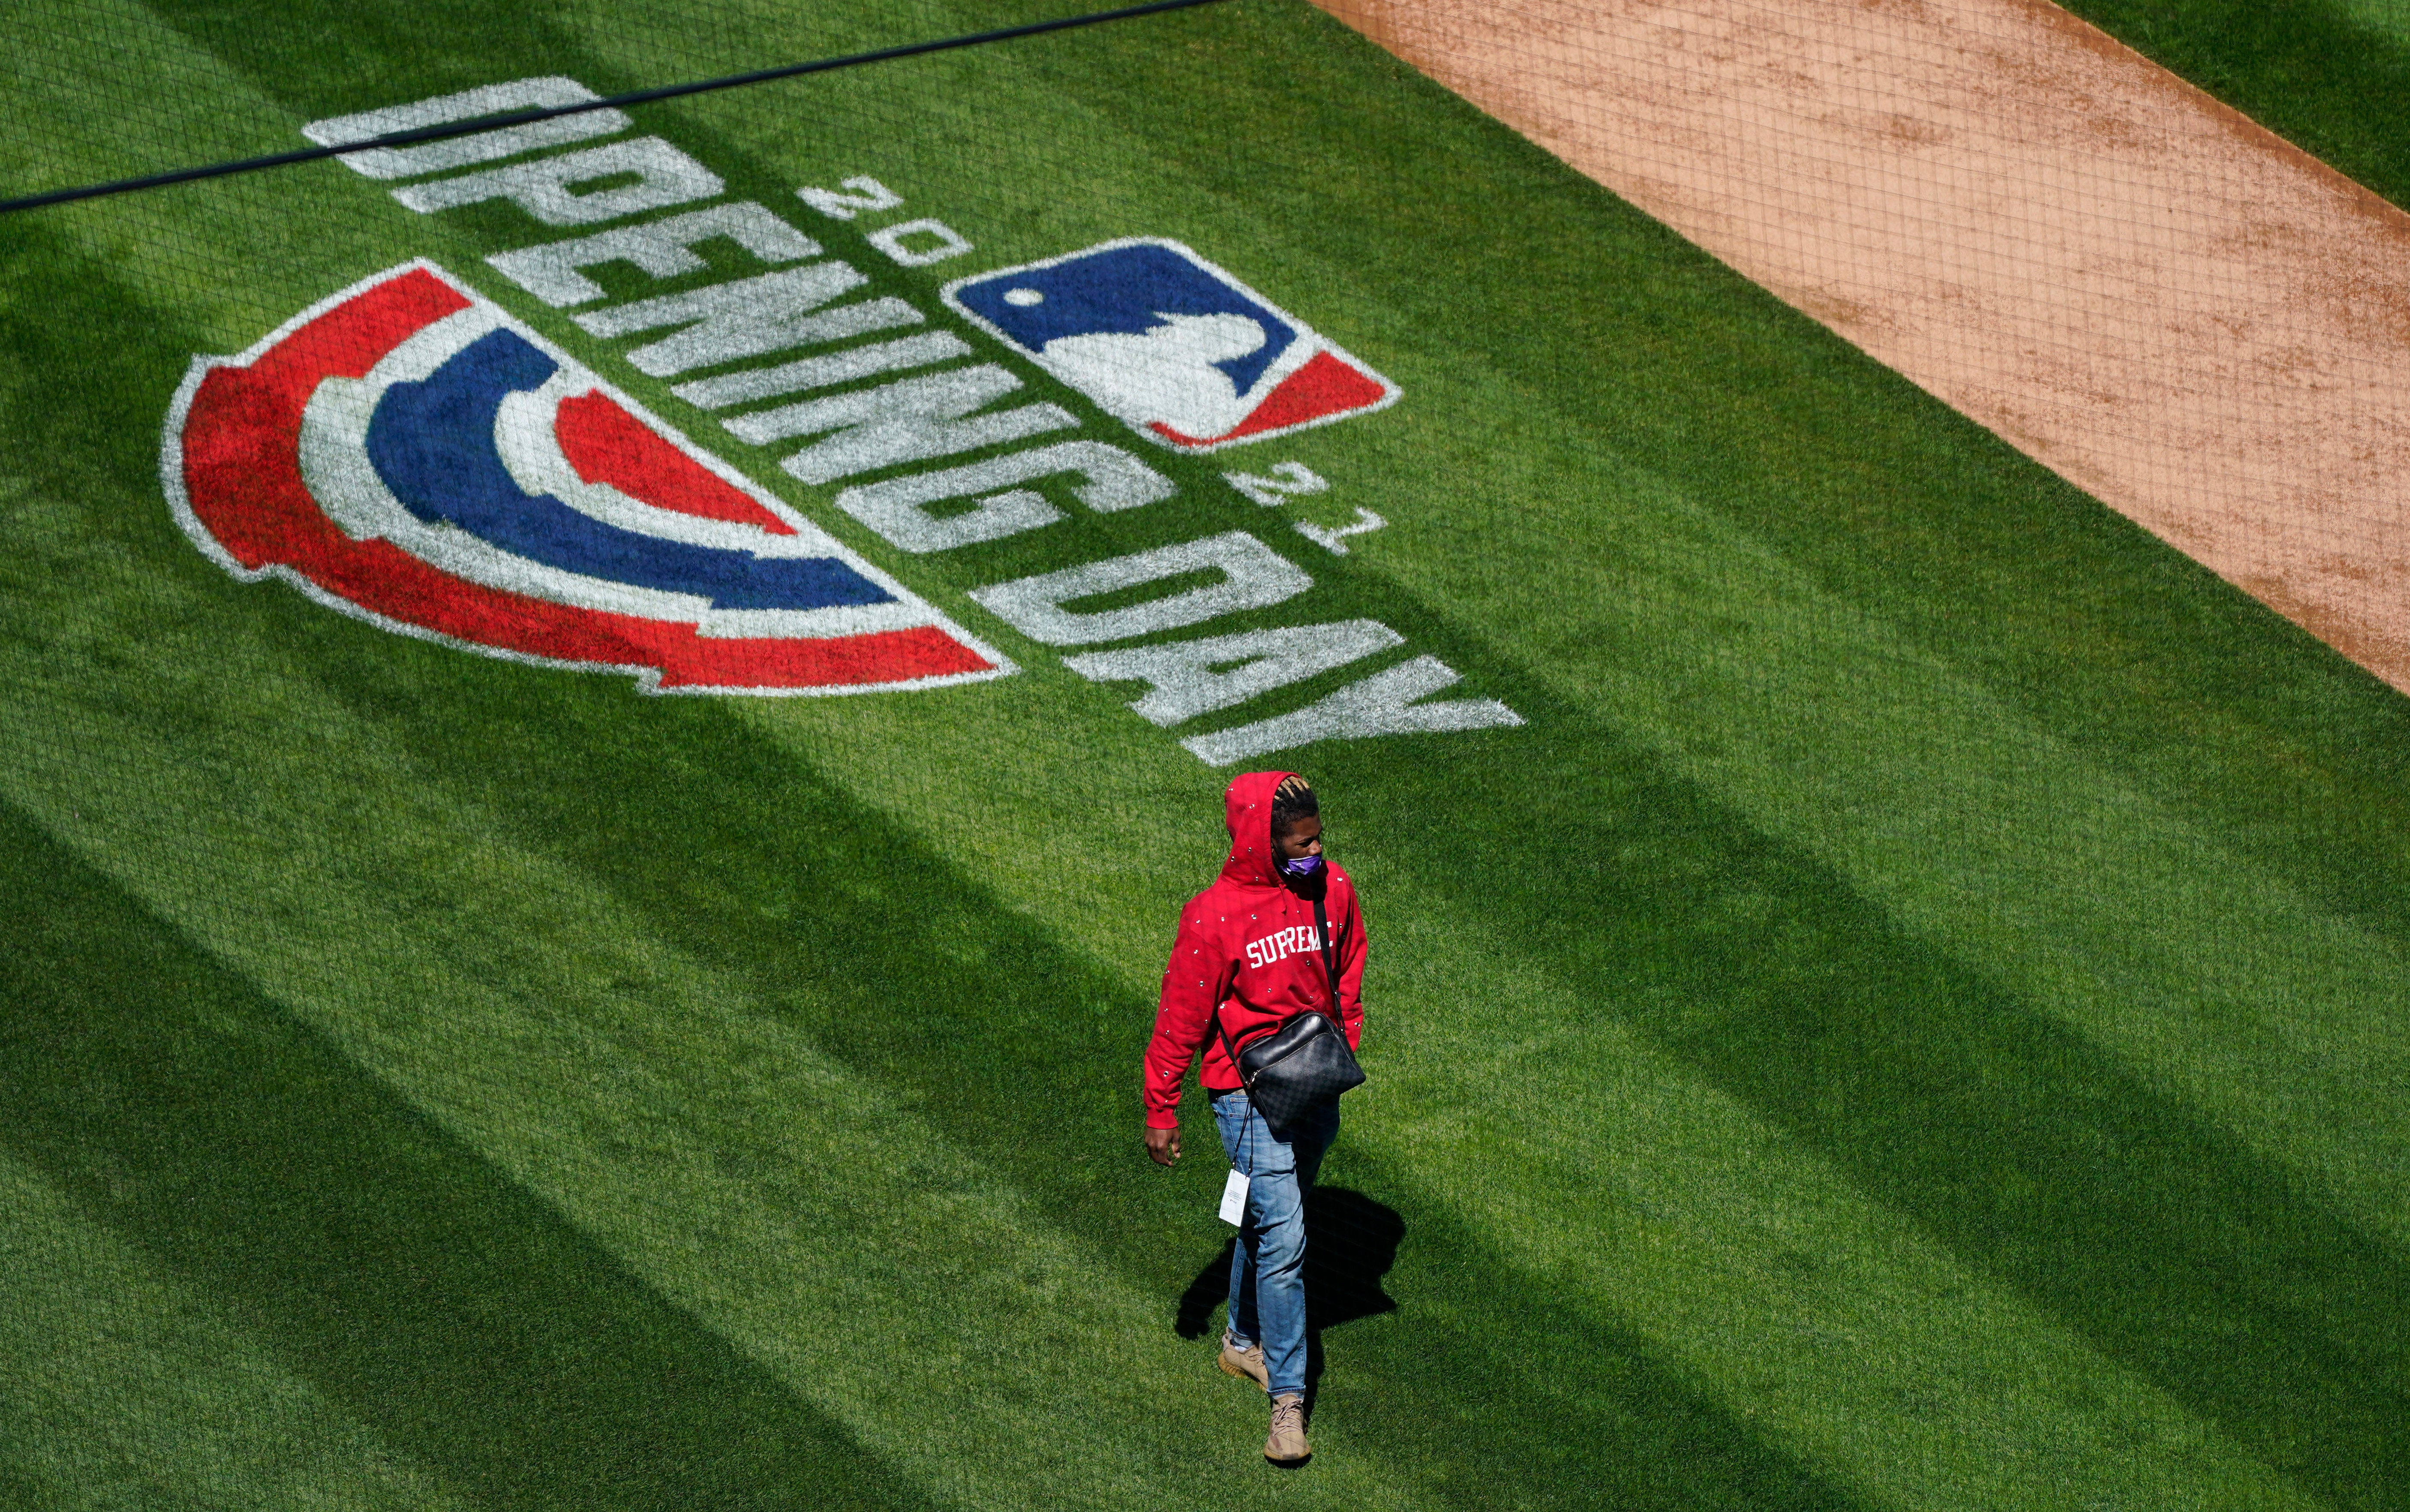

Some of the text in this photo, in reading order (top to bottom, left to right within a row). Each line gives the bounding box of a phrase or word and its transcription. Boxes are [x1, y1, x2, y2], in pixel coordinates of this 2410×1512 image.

[300, 74, 1528, 767] OPENING DAY
[796, 174, 1388, 556] 20 21
